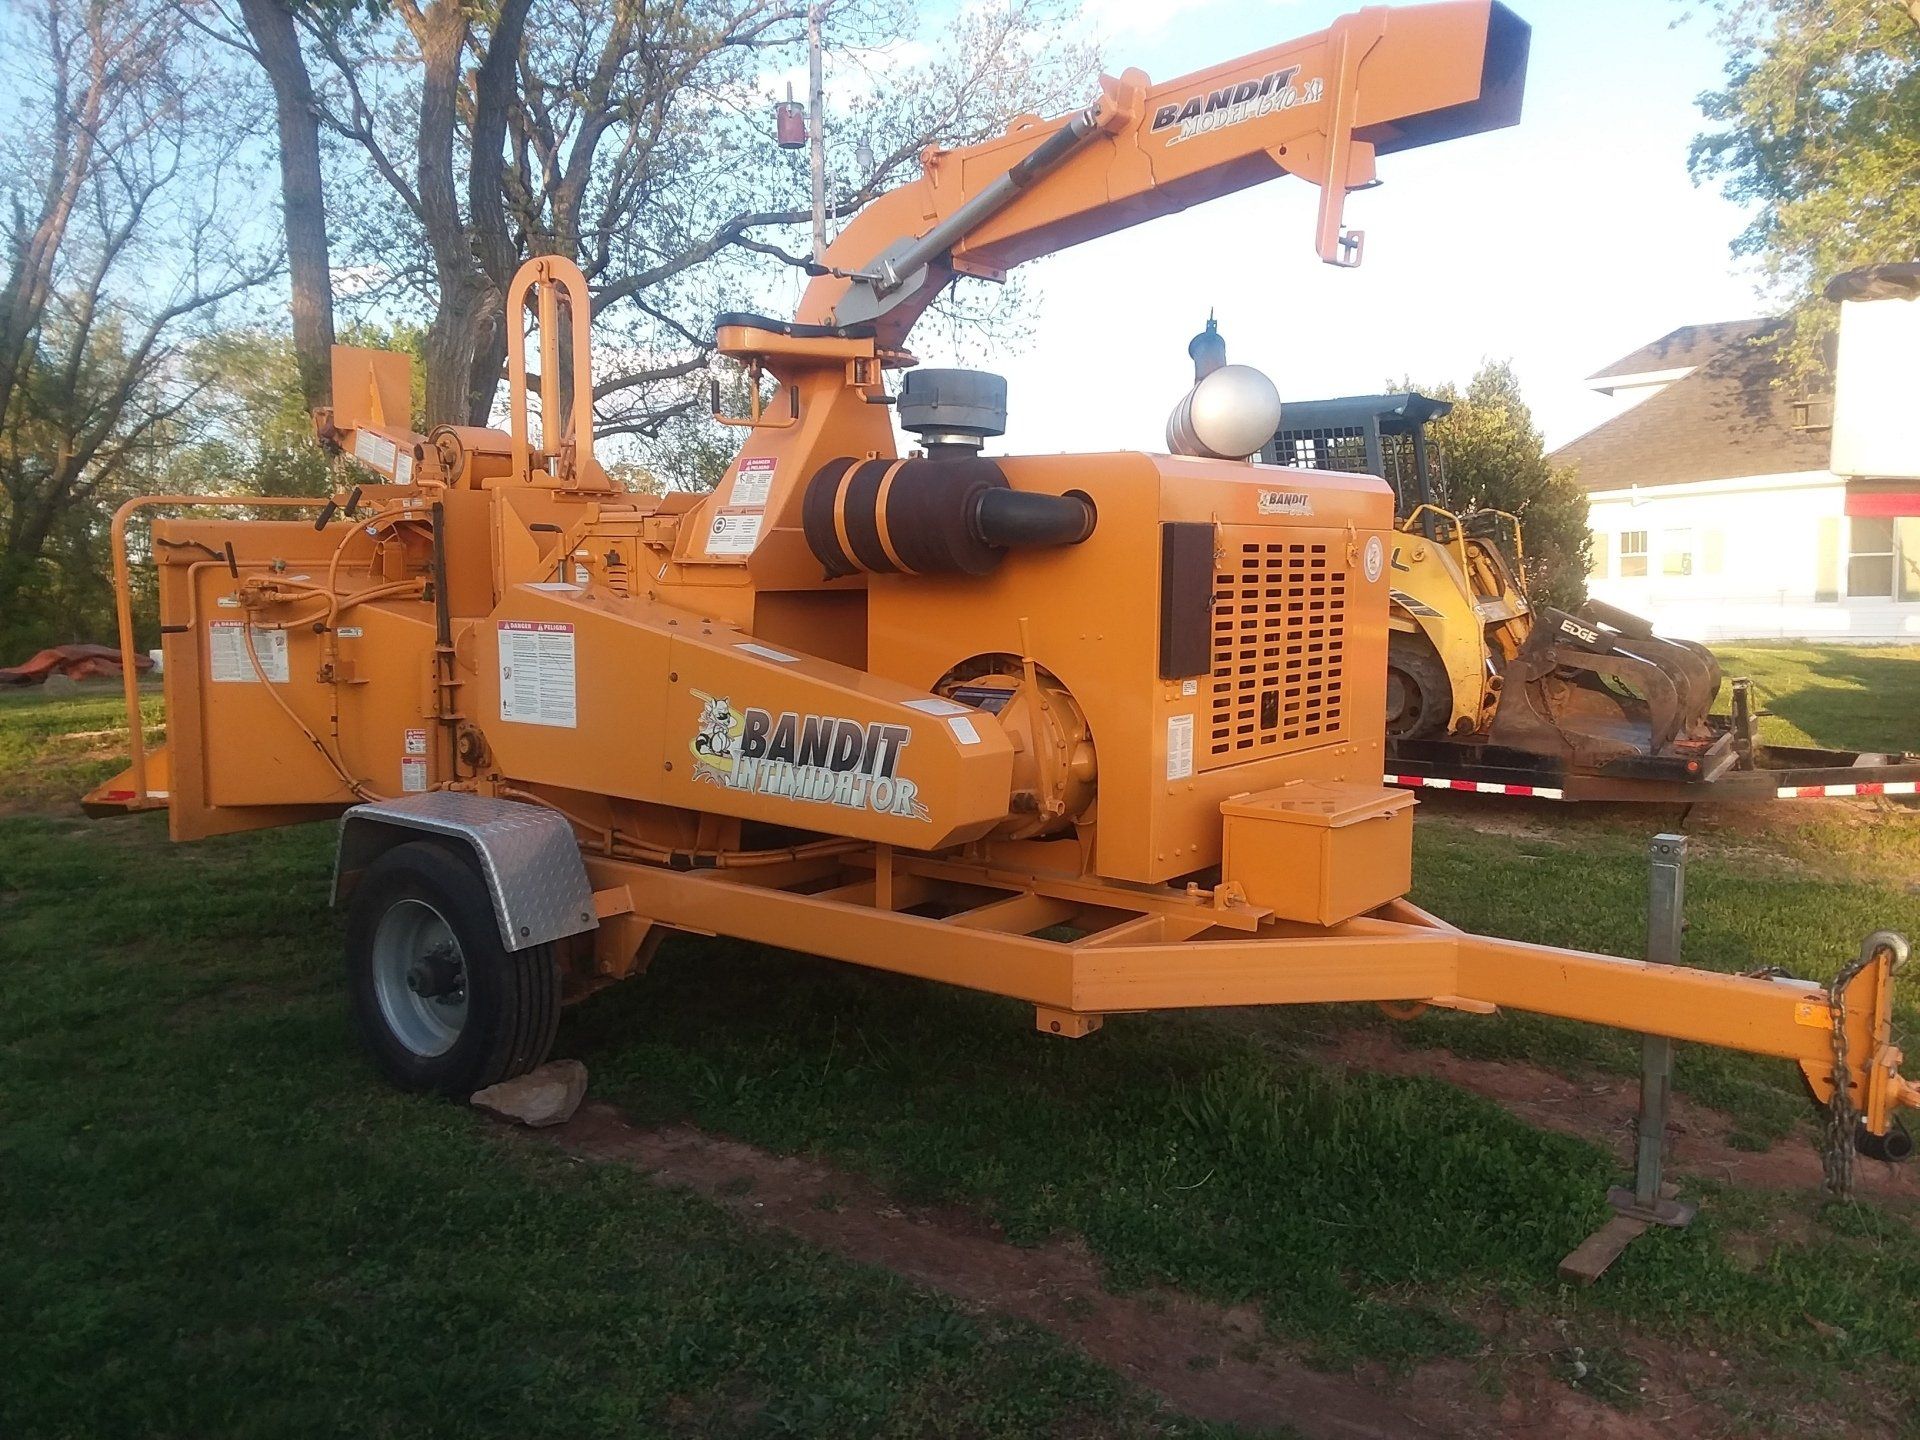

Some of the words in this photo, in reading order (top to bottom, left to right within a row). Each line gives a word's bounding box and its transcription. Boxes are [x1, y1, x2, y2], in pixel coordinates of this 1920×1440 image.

[1151, 65, 1300, 133] BANDIT
[1180, 103, 1250, 138] MODEL
[1269, 492, 1309, 506] BANDIT
[1560, 619, 1599, 644] EDGE
[740, 708, 911, 779] BANDIT
[727, 750, 917, 816] INTIMIDATOR
